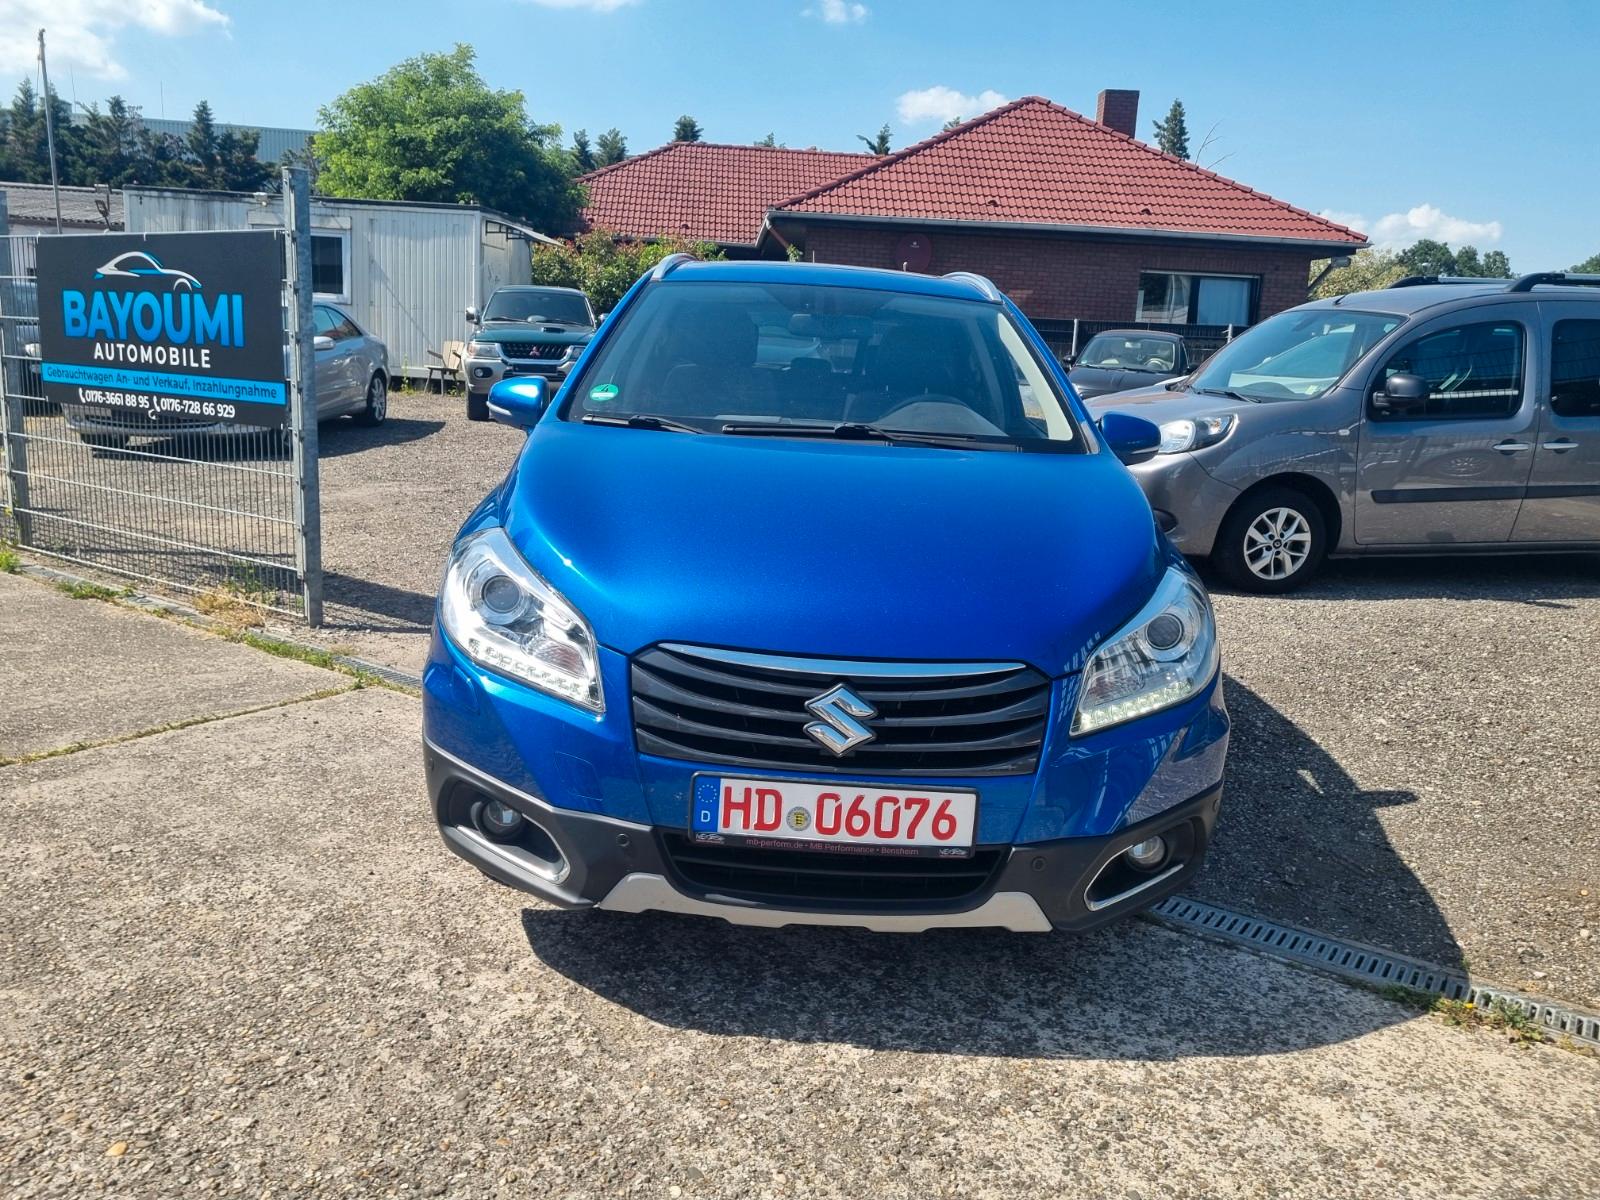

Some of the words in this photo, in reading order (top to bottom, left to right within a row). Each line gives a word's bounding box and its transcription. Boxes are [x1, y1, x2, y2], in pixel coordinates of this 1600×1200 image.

[62, 290, 245, 347] BAYOUMI
[94, 342, 212, 369] AUTOMOBILE
[47, 366, 114, 384] Gebrauchtwagen
[116, 373, 129, 384] An-
[133, 375, 150, 386] und
[152, 376, 191, 391] Verkauf,
[193, 381, 277, 398] Inzahlungnahme
[85, 389, 124, 406] 0176-3661
[125, 394, 137, 407] 88
[138, 395, 150, 409] 95
[160, 398, 201, 414] 0176-728
[202, 402, 216, 416] 66
[217, 404, 236, 418] 929
[701, 811, 711, 822] D
[722, 786, 782, 831] HD
[814, 792, 957, 841] 06076
[746, 839, 804, 850] mb-perform.de
[824, 843, 875, 854] Performance
